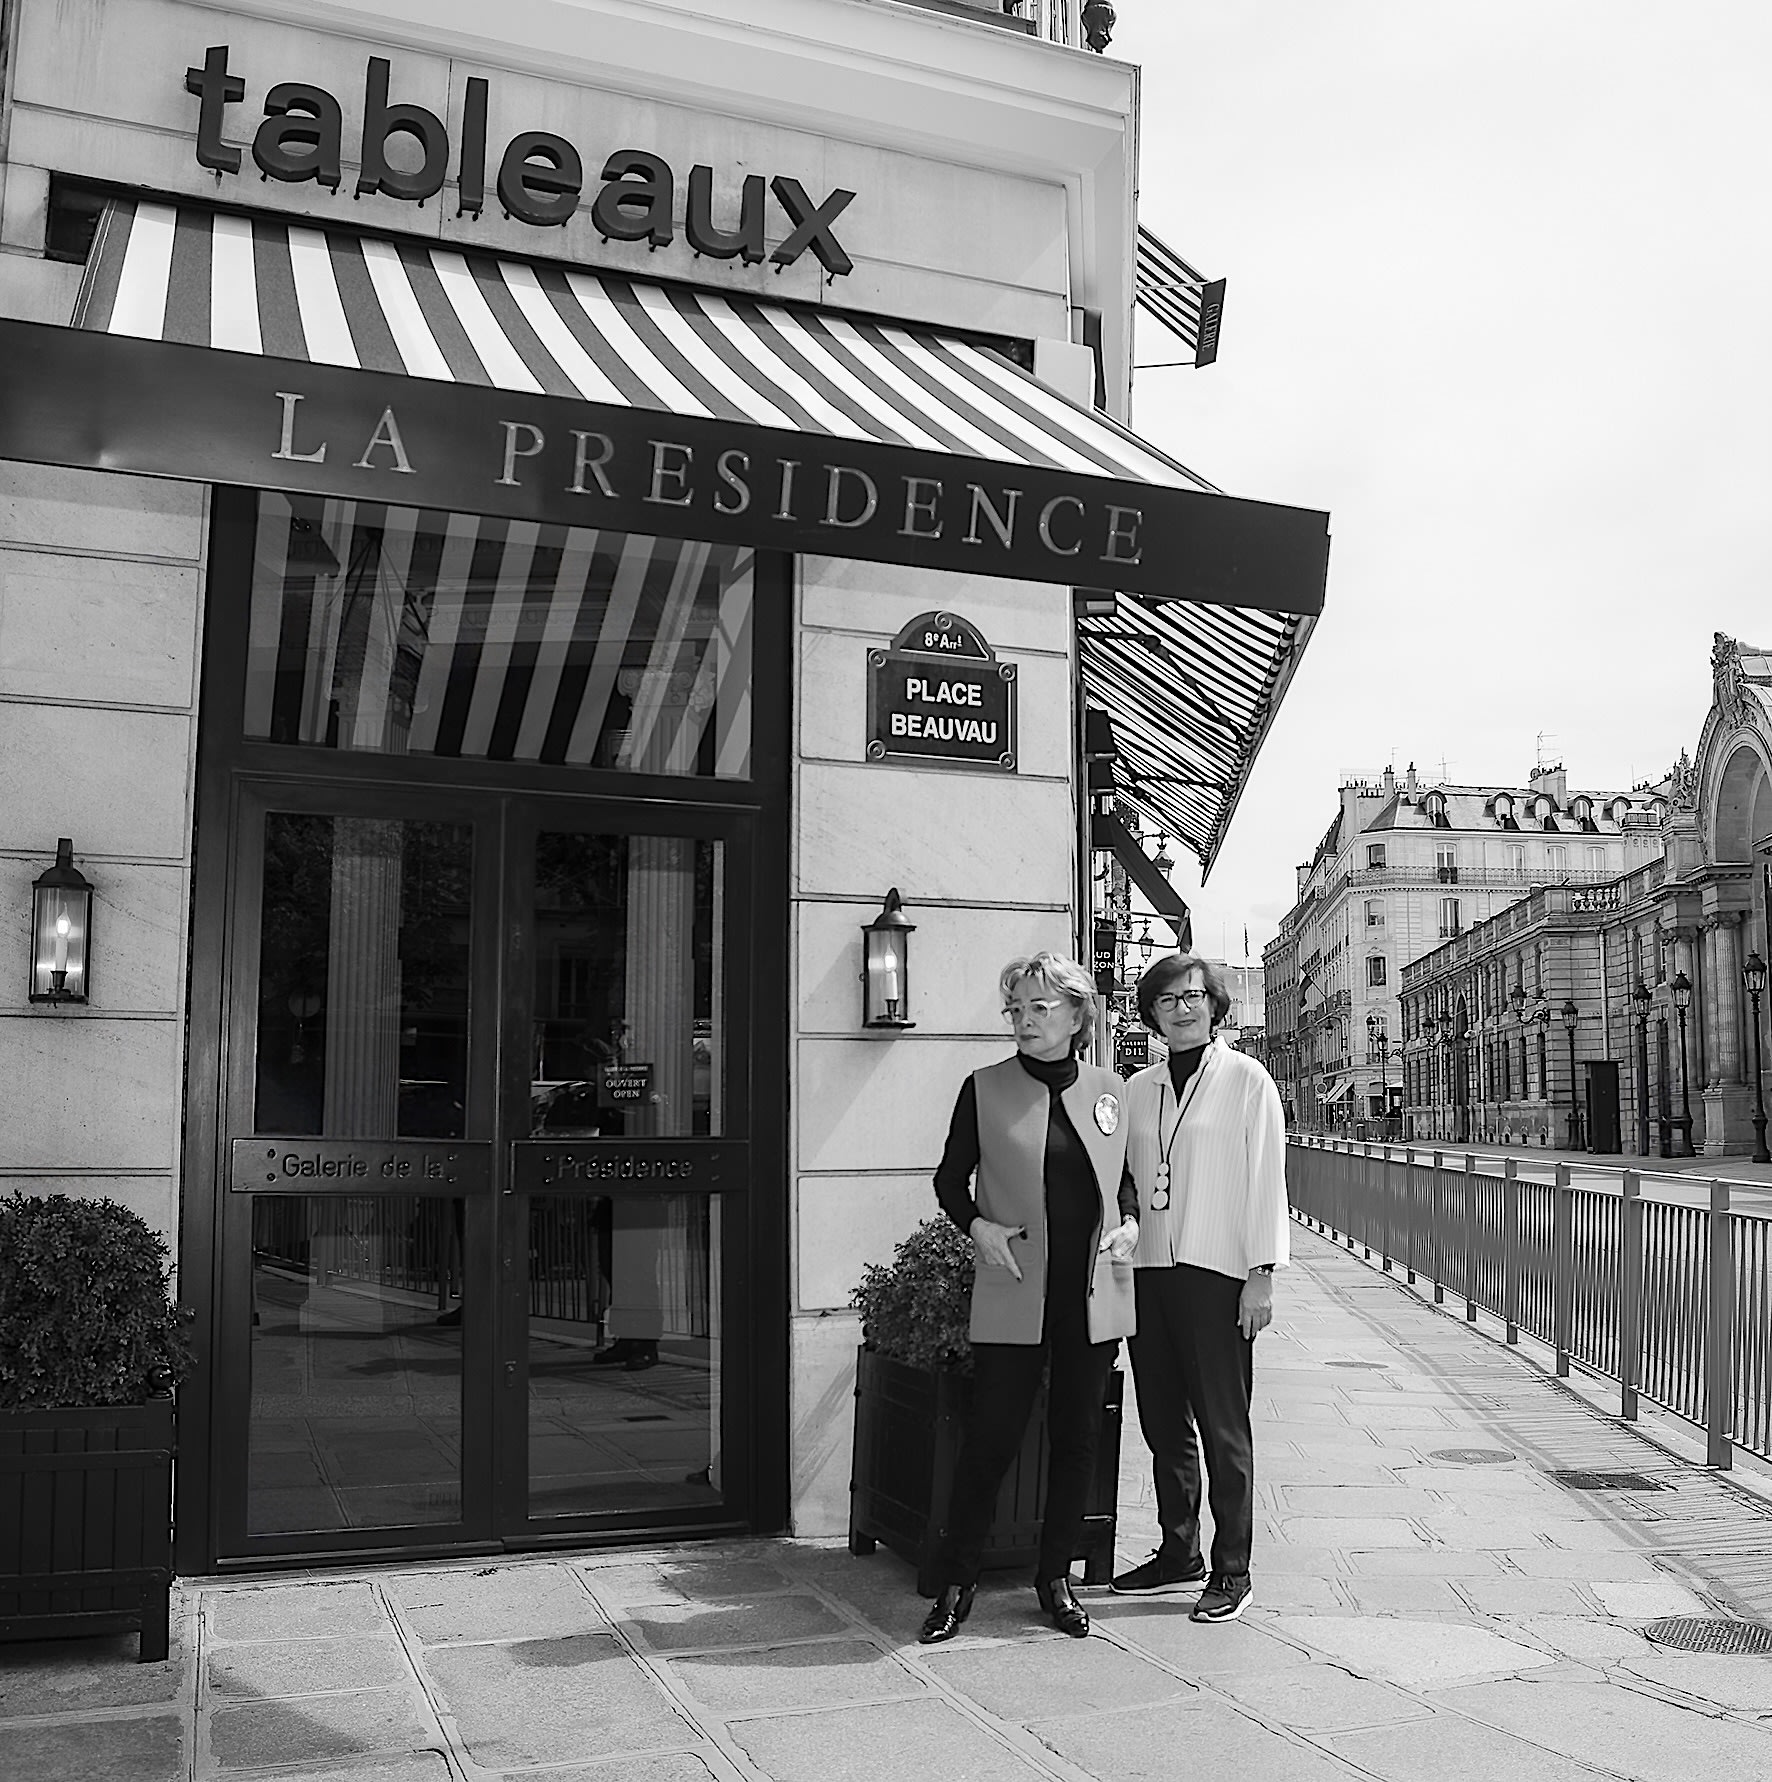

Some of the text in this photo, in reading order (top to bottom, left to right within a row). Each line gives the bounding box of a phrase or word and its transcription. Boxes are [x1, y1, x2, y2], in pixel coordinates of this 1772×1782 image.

[184, 45, 858, 277] tableaux
[1202, 303, 1220, 352] GALERIE
[271, 391, 1143, 566] LA PRESIDENCE
[906, 677, 982, 707] PLACE
[891, 713, 997, 744] BEAUVAU
[1093, 951, 1111, 959] UD
[1125, 1047, 1144, 1056] DIL
[605, 1079, 648, 1088] OUVERT
[613, 1089, 640, 1098] OPEN
[282, 1153, 693, 1178] Galerie de la Présidence
